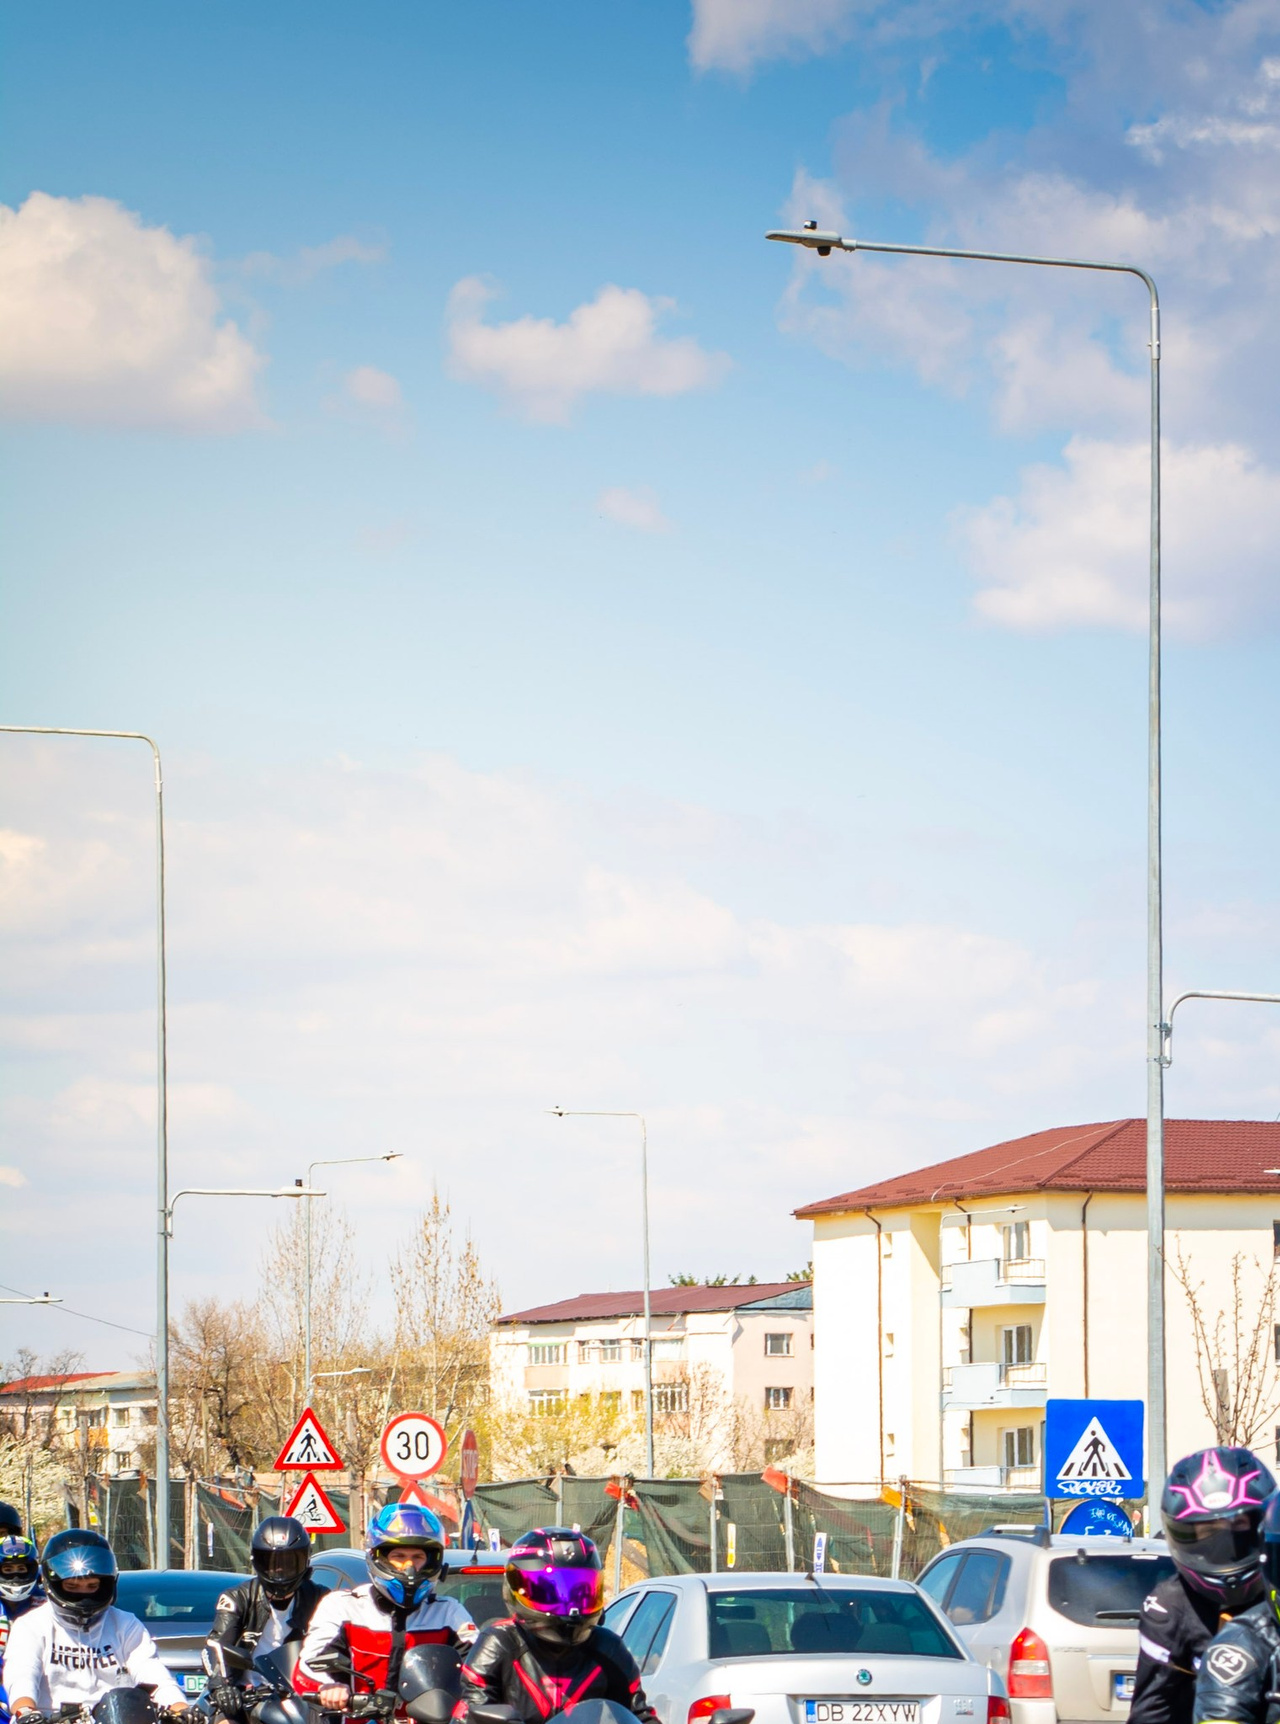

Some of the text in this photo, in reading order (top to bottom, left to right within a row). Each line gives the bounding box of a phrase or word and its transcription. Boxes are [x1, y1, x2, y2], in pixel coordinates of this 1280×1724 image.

[396, 1430, 429, 1460] 30
[462, 1449, 478, 1478] STOP
[817, 1703, 844, 1722] DB
[852, 1703, 917, 1722] 22XYW
